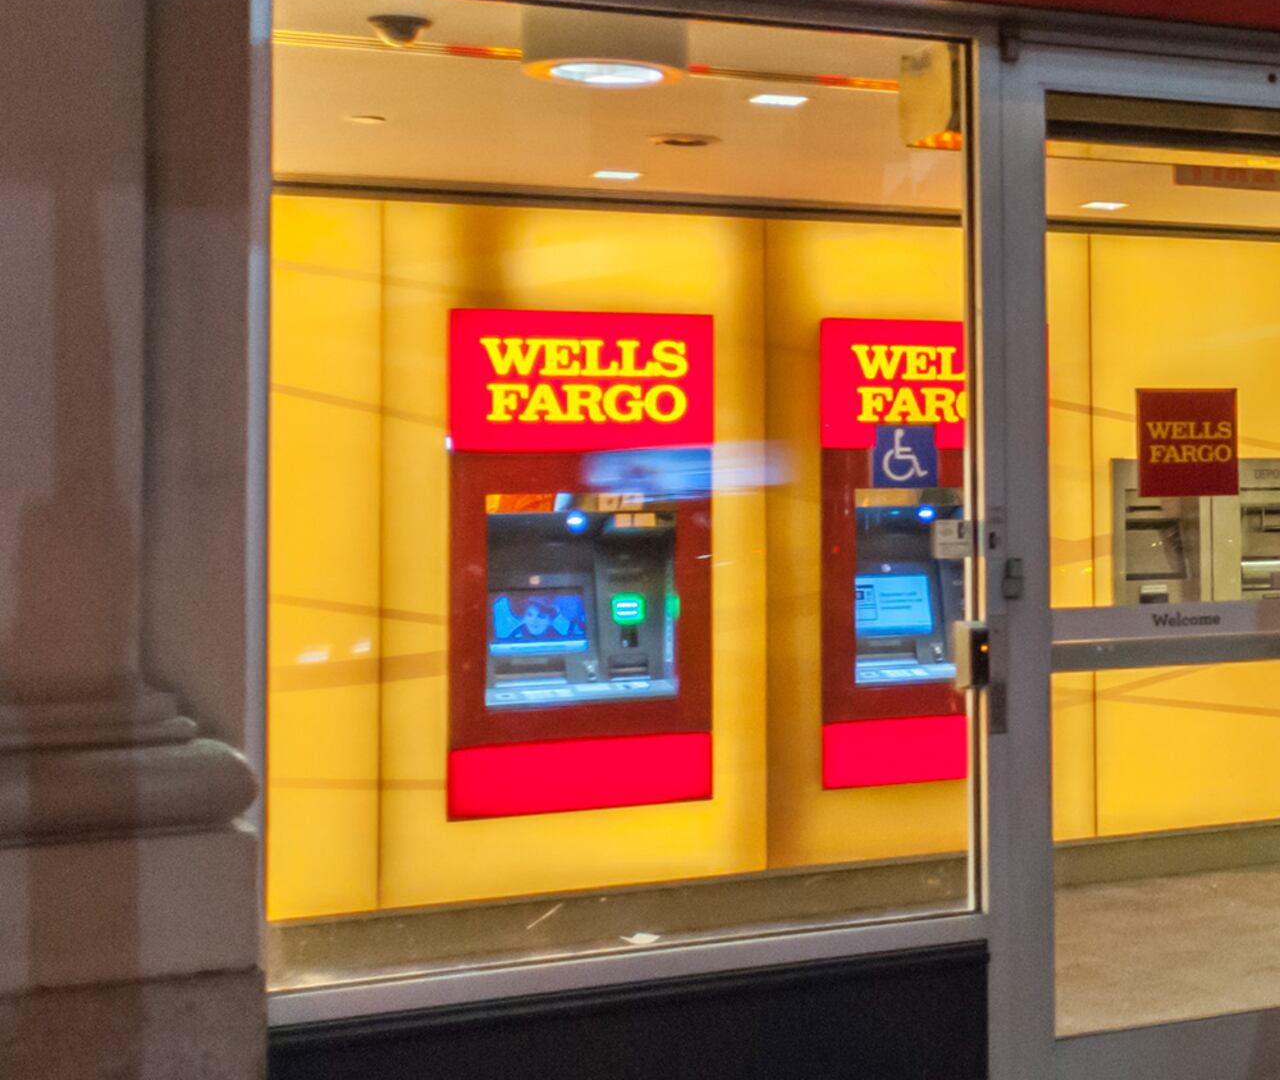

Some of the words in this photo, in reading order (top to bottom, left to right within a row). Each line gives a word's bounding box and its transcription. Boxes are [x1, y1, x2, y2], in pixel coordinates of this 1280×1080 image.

[480, 337, 689, 378] WELLS
[486, 383, 688, 423] FARGO
[1146, 421, 1232, 440] WELLS
[1150, 444, 1232, 463] FARGO
[1152, 612, 1221, 628] Welcome
